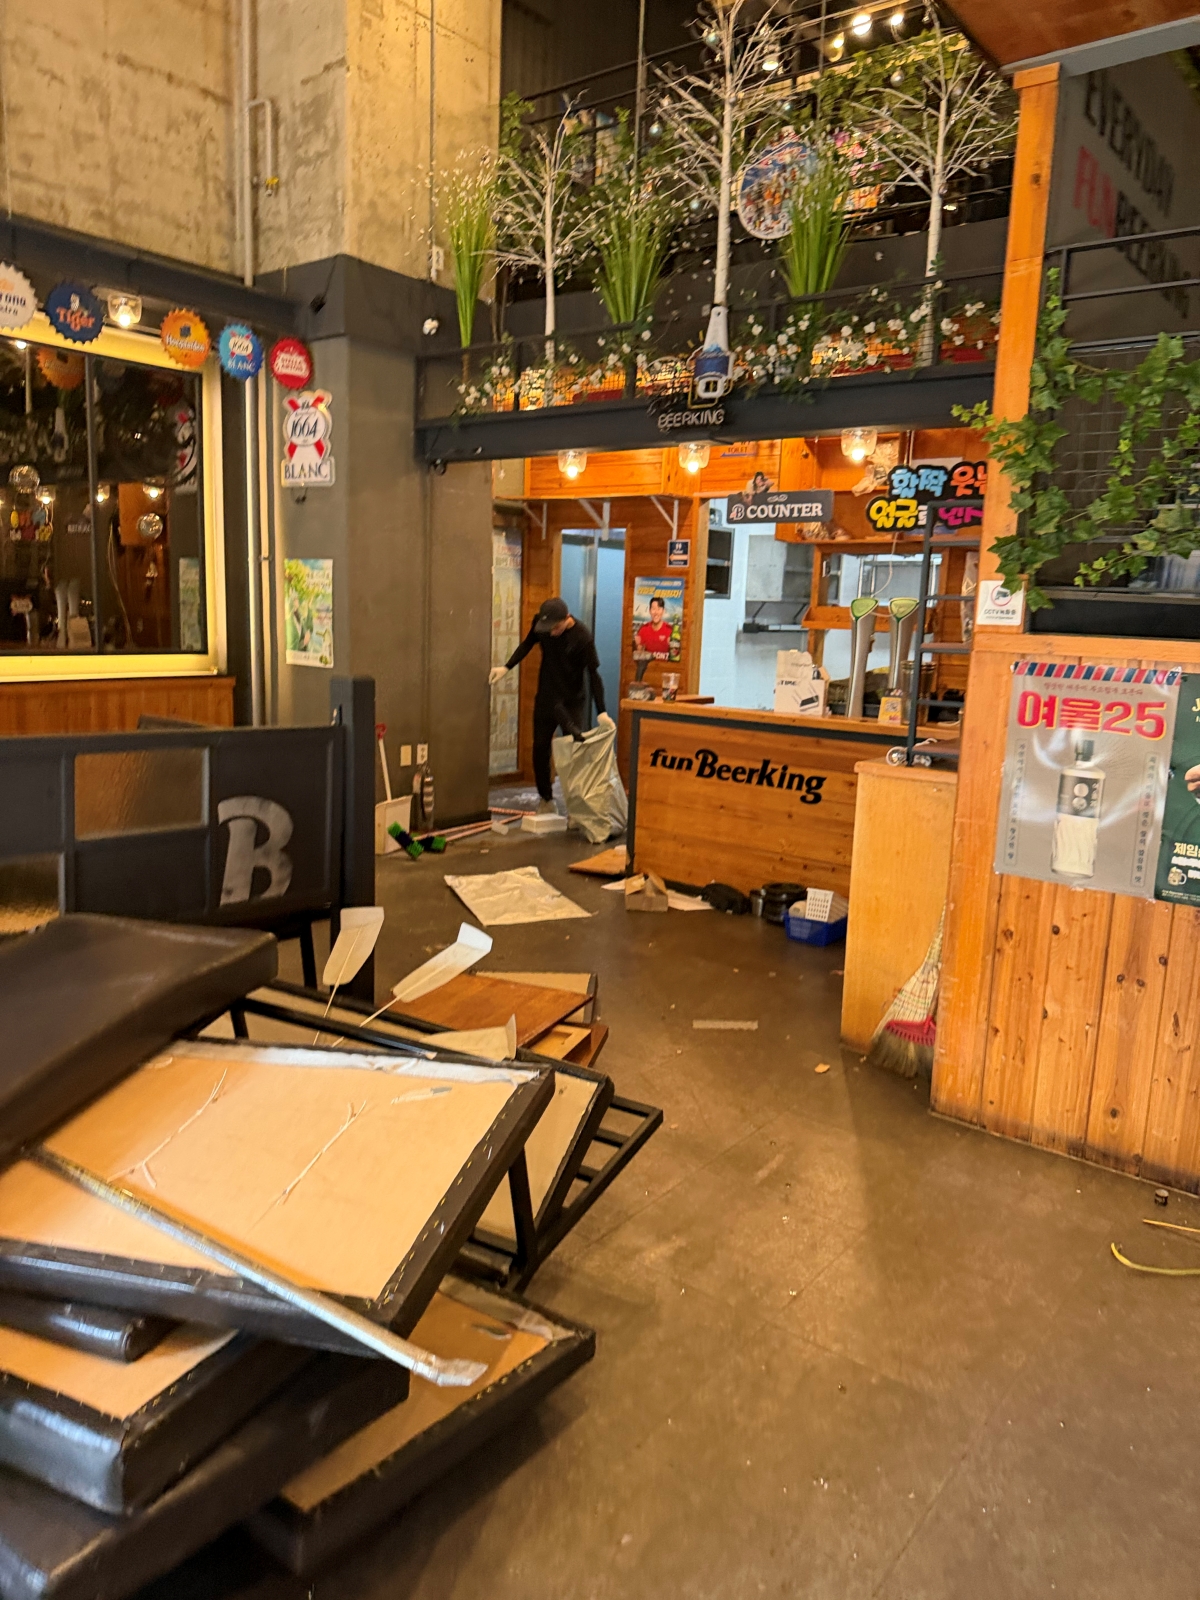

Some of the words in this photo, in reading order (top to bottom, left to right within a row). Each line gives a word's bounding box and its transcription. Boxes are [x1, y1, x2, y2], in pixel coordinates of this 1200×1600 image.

[1072, 145, 1117, 239] FUN
[56, 307, 95, 332] Tiger
[228, 358, 255, 373] BLANC
[290, 416, 319, 439] 1664
[657, 409, 725, 429] BEERKING
[284, 461, 328, 480] BLANC
[891, 468, 948, 498] 활짝
[746, 502, 823, 519] COUNTER
[1016, 690, 1168, 741] 여울25
[650, 748, 693, 772] fun
[695, 748, 828, 805] Beerking
[217, 796, 294, 907] B
